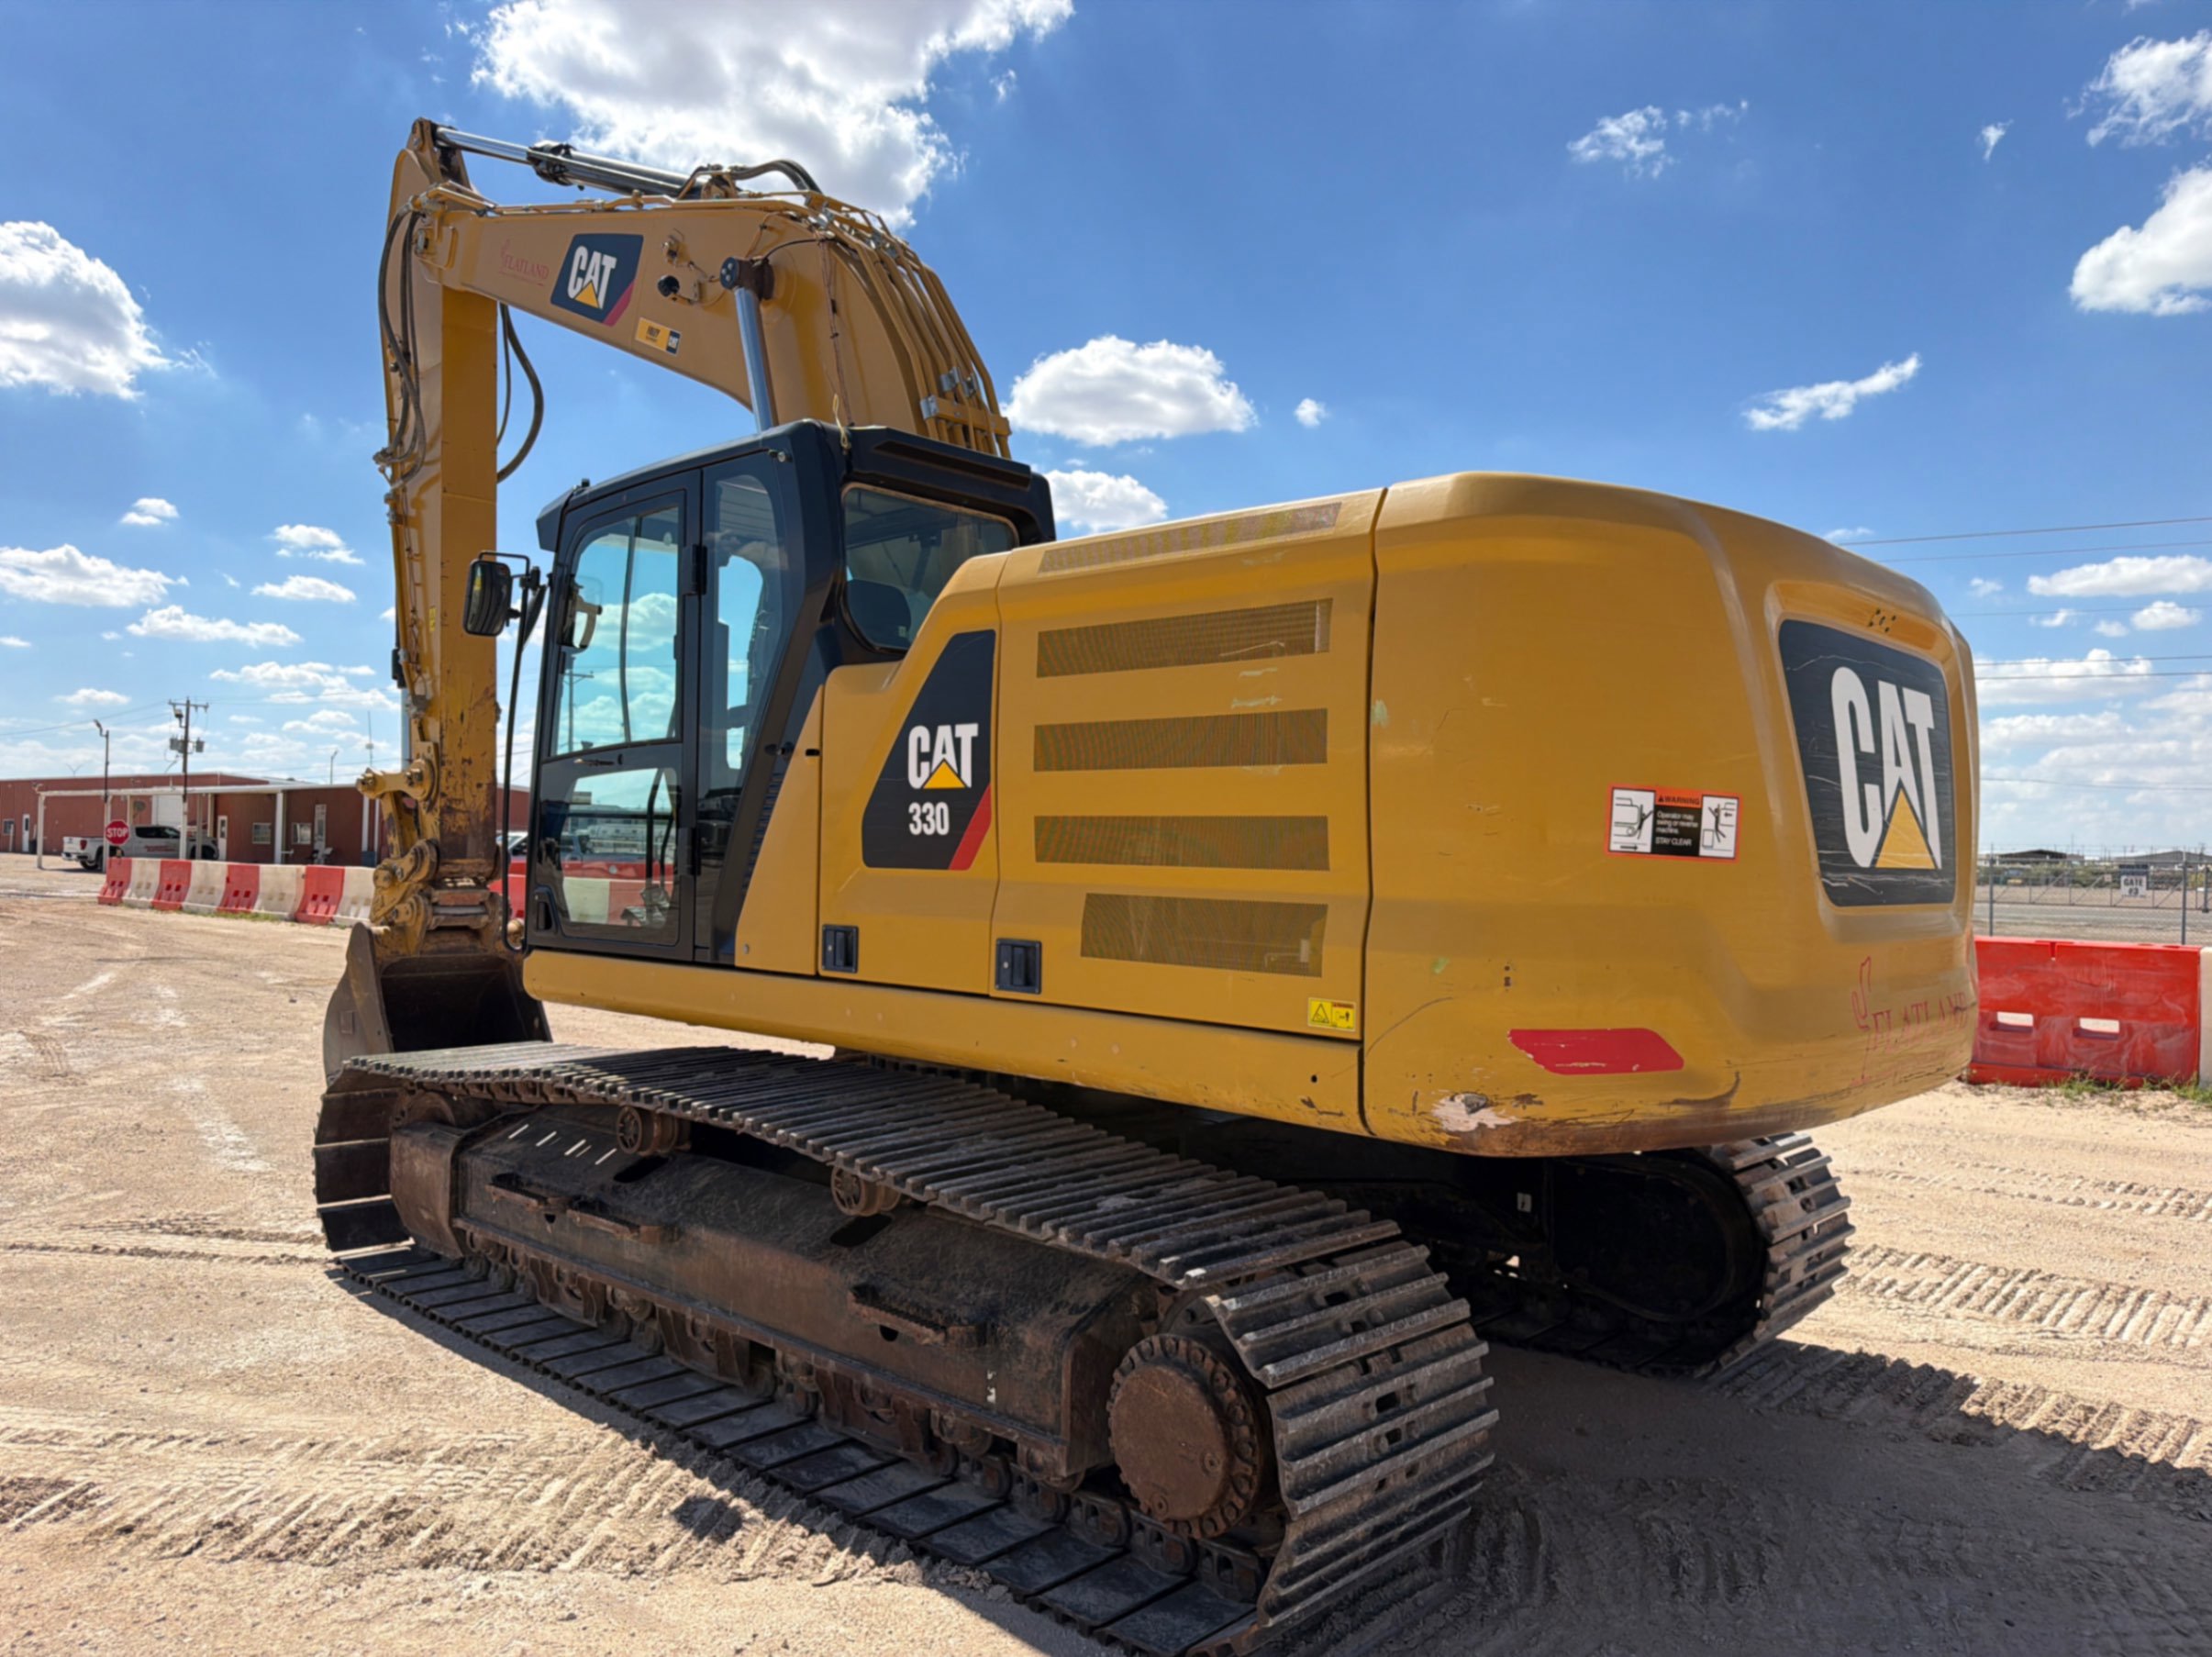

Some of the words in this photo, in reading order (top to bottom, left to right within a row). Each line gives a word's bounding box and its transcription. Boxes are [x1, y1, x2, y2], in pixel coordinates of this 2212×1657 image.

[567, 245, 617, 309] CAT
[908, 723, 979, 789] CAT
[1831, 666, 1942, 870] CAT
[1664, 795, 1699, 806] WARNING
[908, 802, 950, 836] 330
[1657, 811, 1681, 820] Operator
[106, 828, 128, 838] STOP
[1655, 836, 1671, 844] STAY
[1672, 838, 1693, 846] CLEAR
[2123, 878, 2143, 886] GATE
